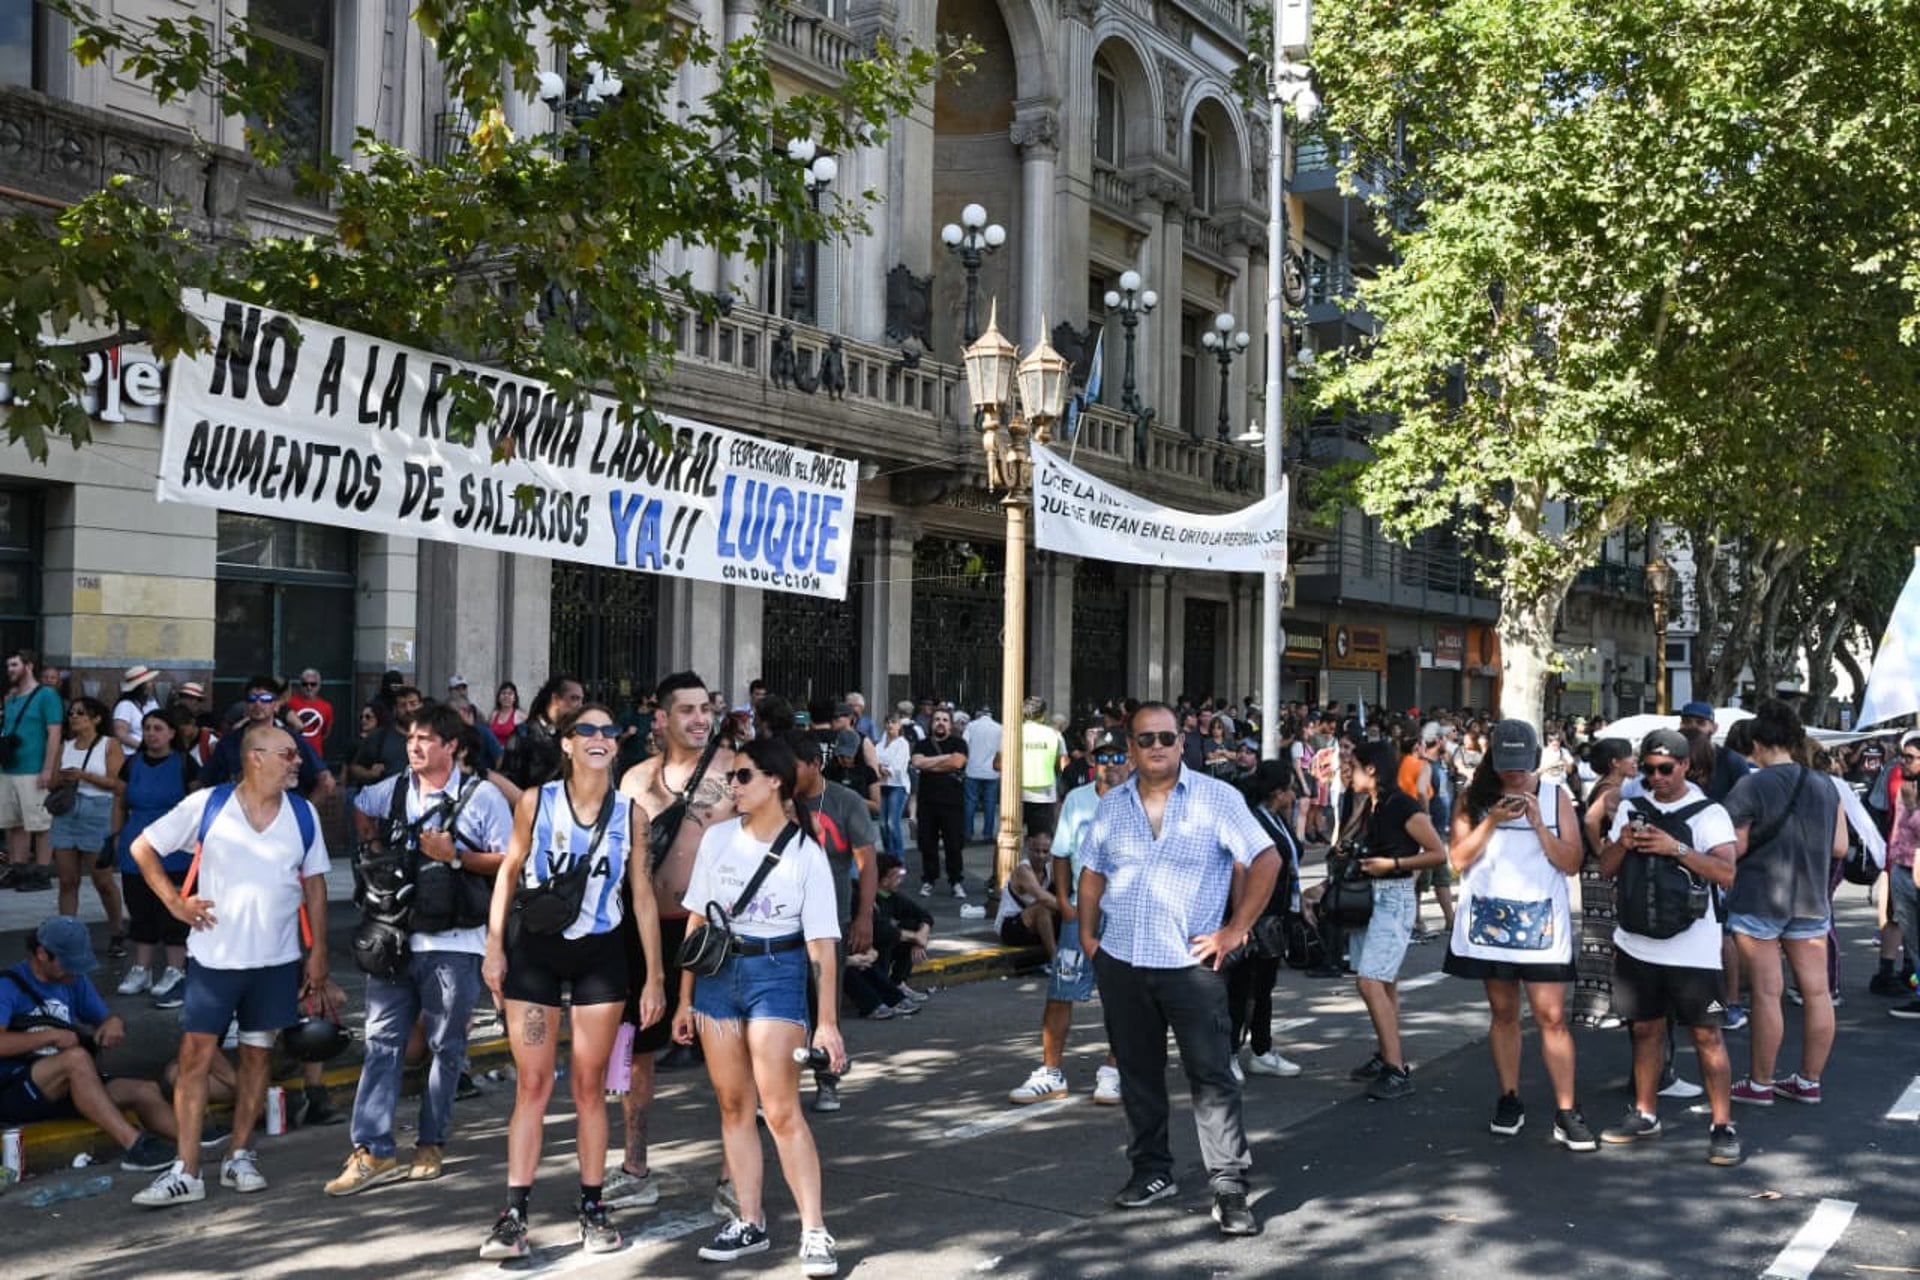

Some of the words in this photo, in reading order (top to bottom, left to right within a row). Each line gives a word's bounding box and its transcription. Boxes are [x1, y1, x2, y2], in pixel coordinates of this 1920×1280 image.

[209, 302, 301, 407] NO
[314, 336, 346, 418] A
[358, 345, 408, 431] LA
[589, 407, 722, 497] LABORAL
[182, 419, 382, 512] AUMENTOS
[398, 461, 445, 522] DE
[609, 489, 703, 571] YA!!
[794, 461, 808, 481] DEL
[810, 455, 846, 489] PAPEL
[1073, 482, 1095, 502] LA
[718, 474, 843, 576] LUQUE
[1088, 509, 1139, 535] METAN
[1140, 521, 1160, 542] EN
[1161, 525, 1176, 542] EL
